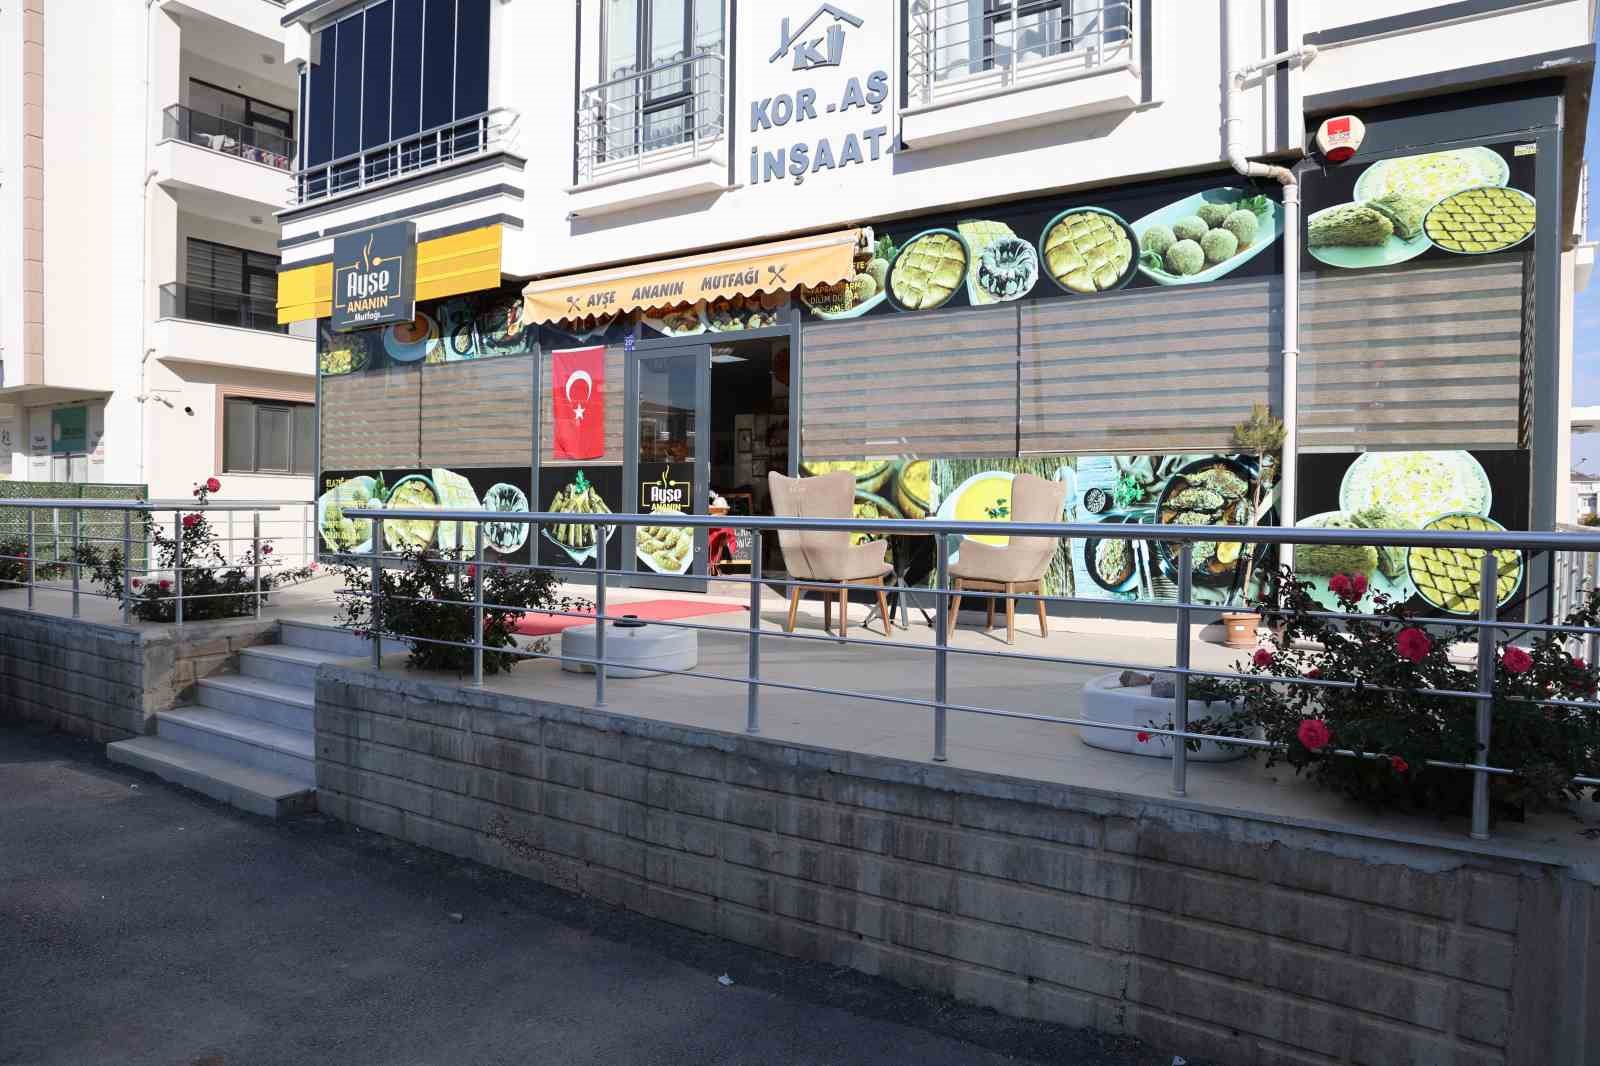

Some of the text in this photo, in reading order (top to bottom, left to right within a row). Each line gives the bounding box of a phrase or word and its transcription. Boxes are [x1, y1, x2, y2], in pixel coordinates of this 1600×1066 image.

[750, 87, 817, 133] KOR
[750, 126, 888, 186] İNŞAAT
[347, 270, 390, 298] Ayşe
[347, 295, 388, 313] ANANIN
[586, 266, 760, 309] AYŞE ANANIN MUTFAĞI
